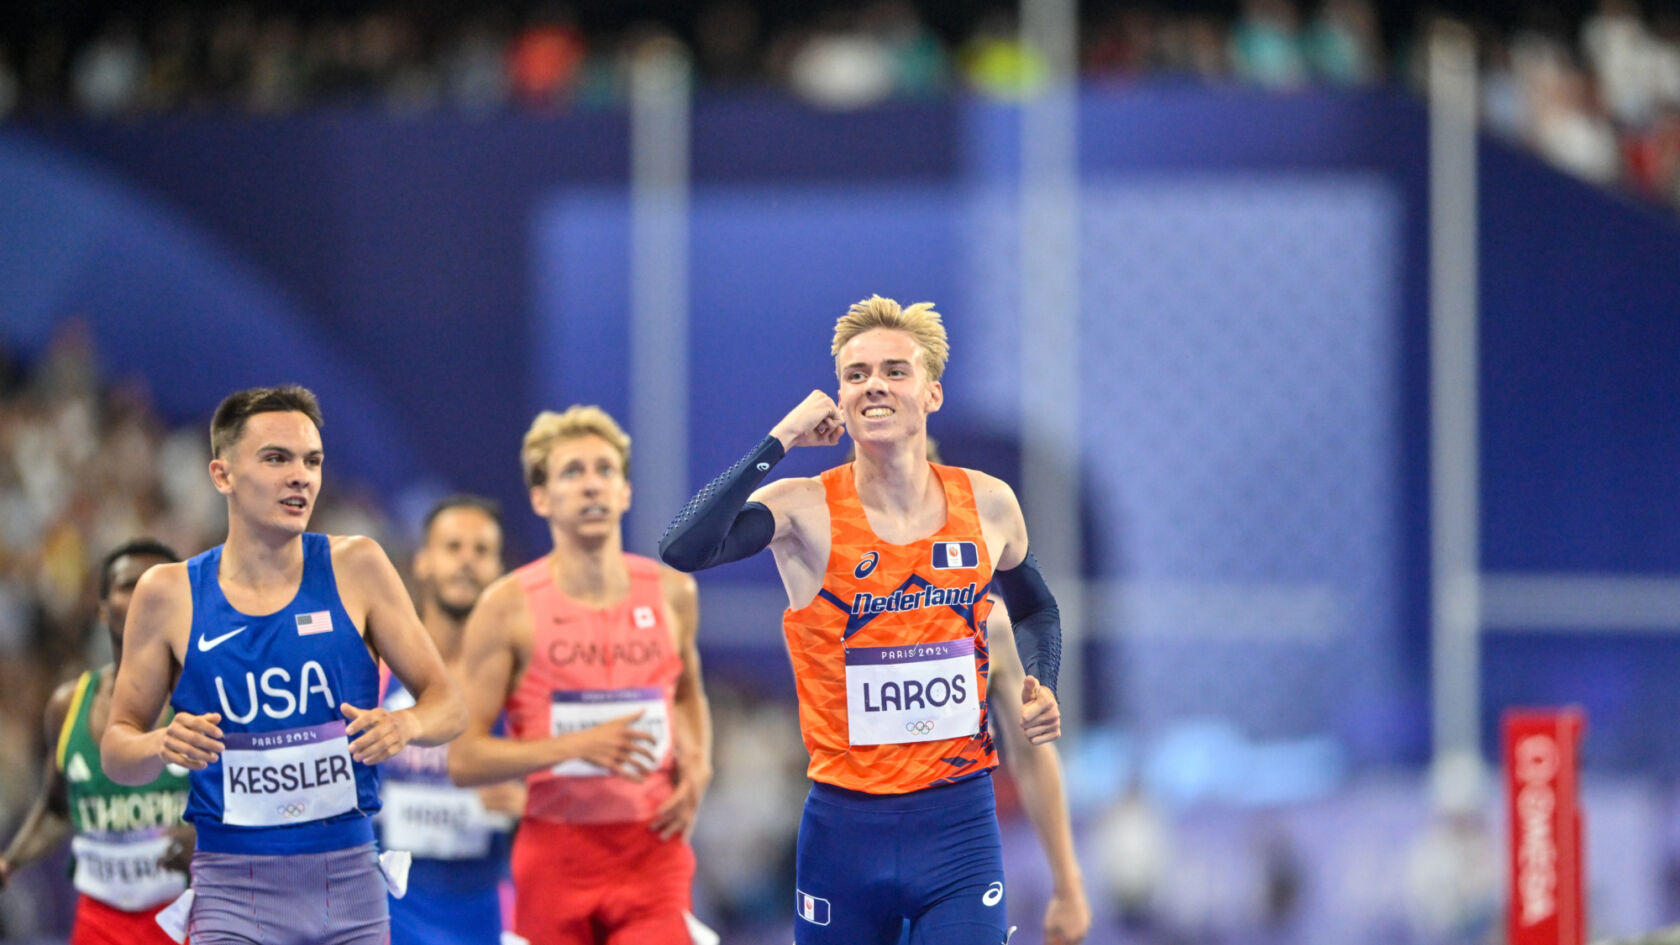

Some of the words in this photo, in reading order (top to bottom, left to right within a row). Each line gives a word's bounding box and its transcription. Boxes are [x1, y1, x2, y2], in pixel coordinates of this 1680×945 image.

[548, 640, 662, 667] CANADA
[881, 649, 916, 660] PARIS
[918, 646, 949, 657] 2024
[214, 660, 335, 724] USA
[863, 673, 967, 713] LAROS
[252, 735, 283, 747] PARIS
[285, 731, 317, 744] 2024
[228, 754, 351, 794] KESSLER
